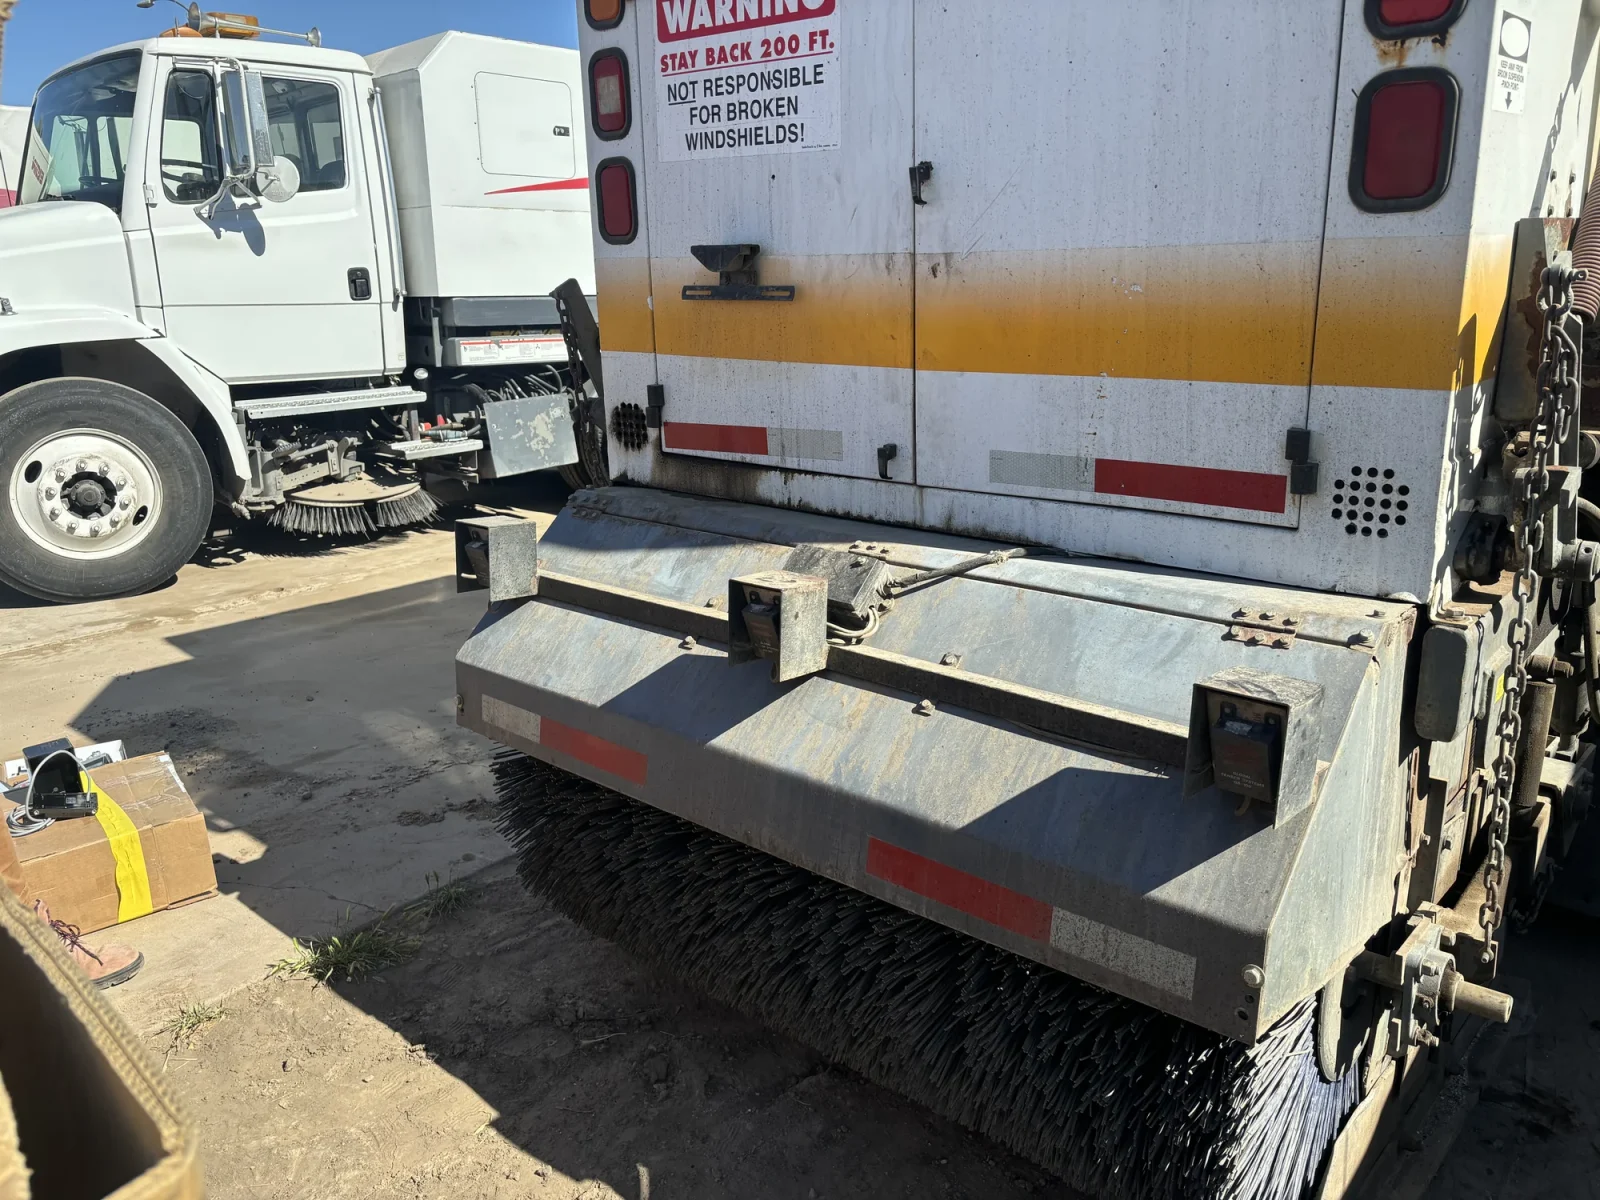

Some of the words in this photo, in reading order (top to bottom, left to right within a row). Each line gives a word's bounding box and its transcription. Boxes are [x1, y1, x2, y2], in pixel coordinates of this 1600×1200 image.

[662, 0, 825, 34] WARNI
[660, 50, 699, 73] STAY
[705, 41, 752, 66] BACK
[760, 34, 800, 59] 200
[808, 29, 835, 52] FT.
[667, 80, 698, 102] NOT
[703, 64, 824, 98] RESPONSIBLE
[689, 104, 721, 126] FOR
[726, 96, 799, 122] BROKEN
[685, 123, 805, 151] WINDSHIELDS!
